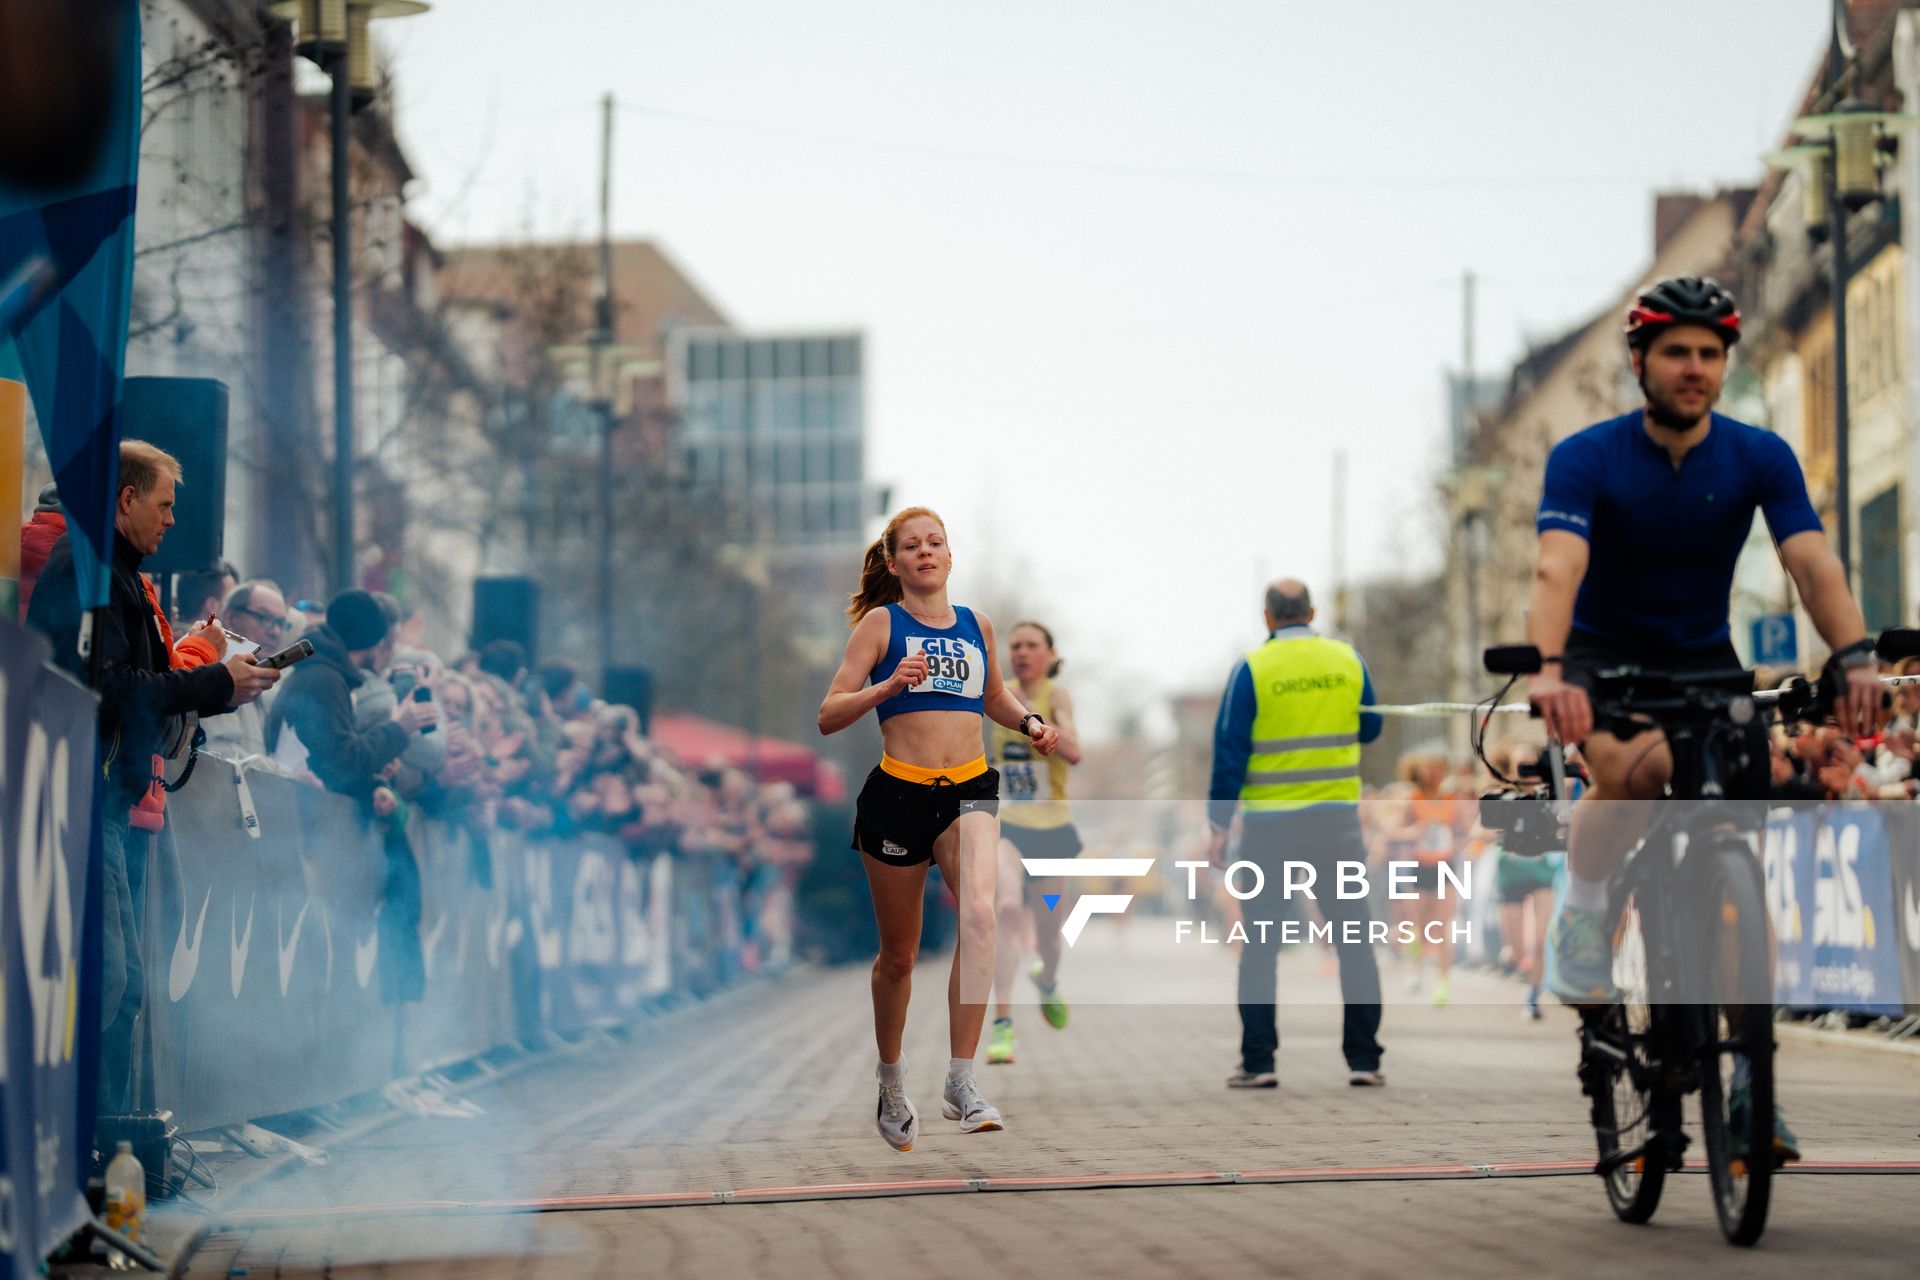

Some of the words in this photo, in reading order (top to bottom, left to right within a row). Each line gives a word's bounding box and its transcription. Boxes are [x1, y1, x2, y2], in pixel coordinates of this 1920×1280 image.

[1762, 617, 1788, 657] P
[926, 655, 970, 681] 930
[1271, 672, 1346, 696] ORDNER
